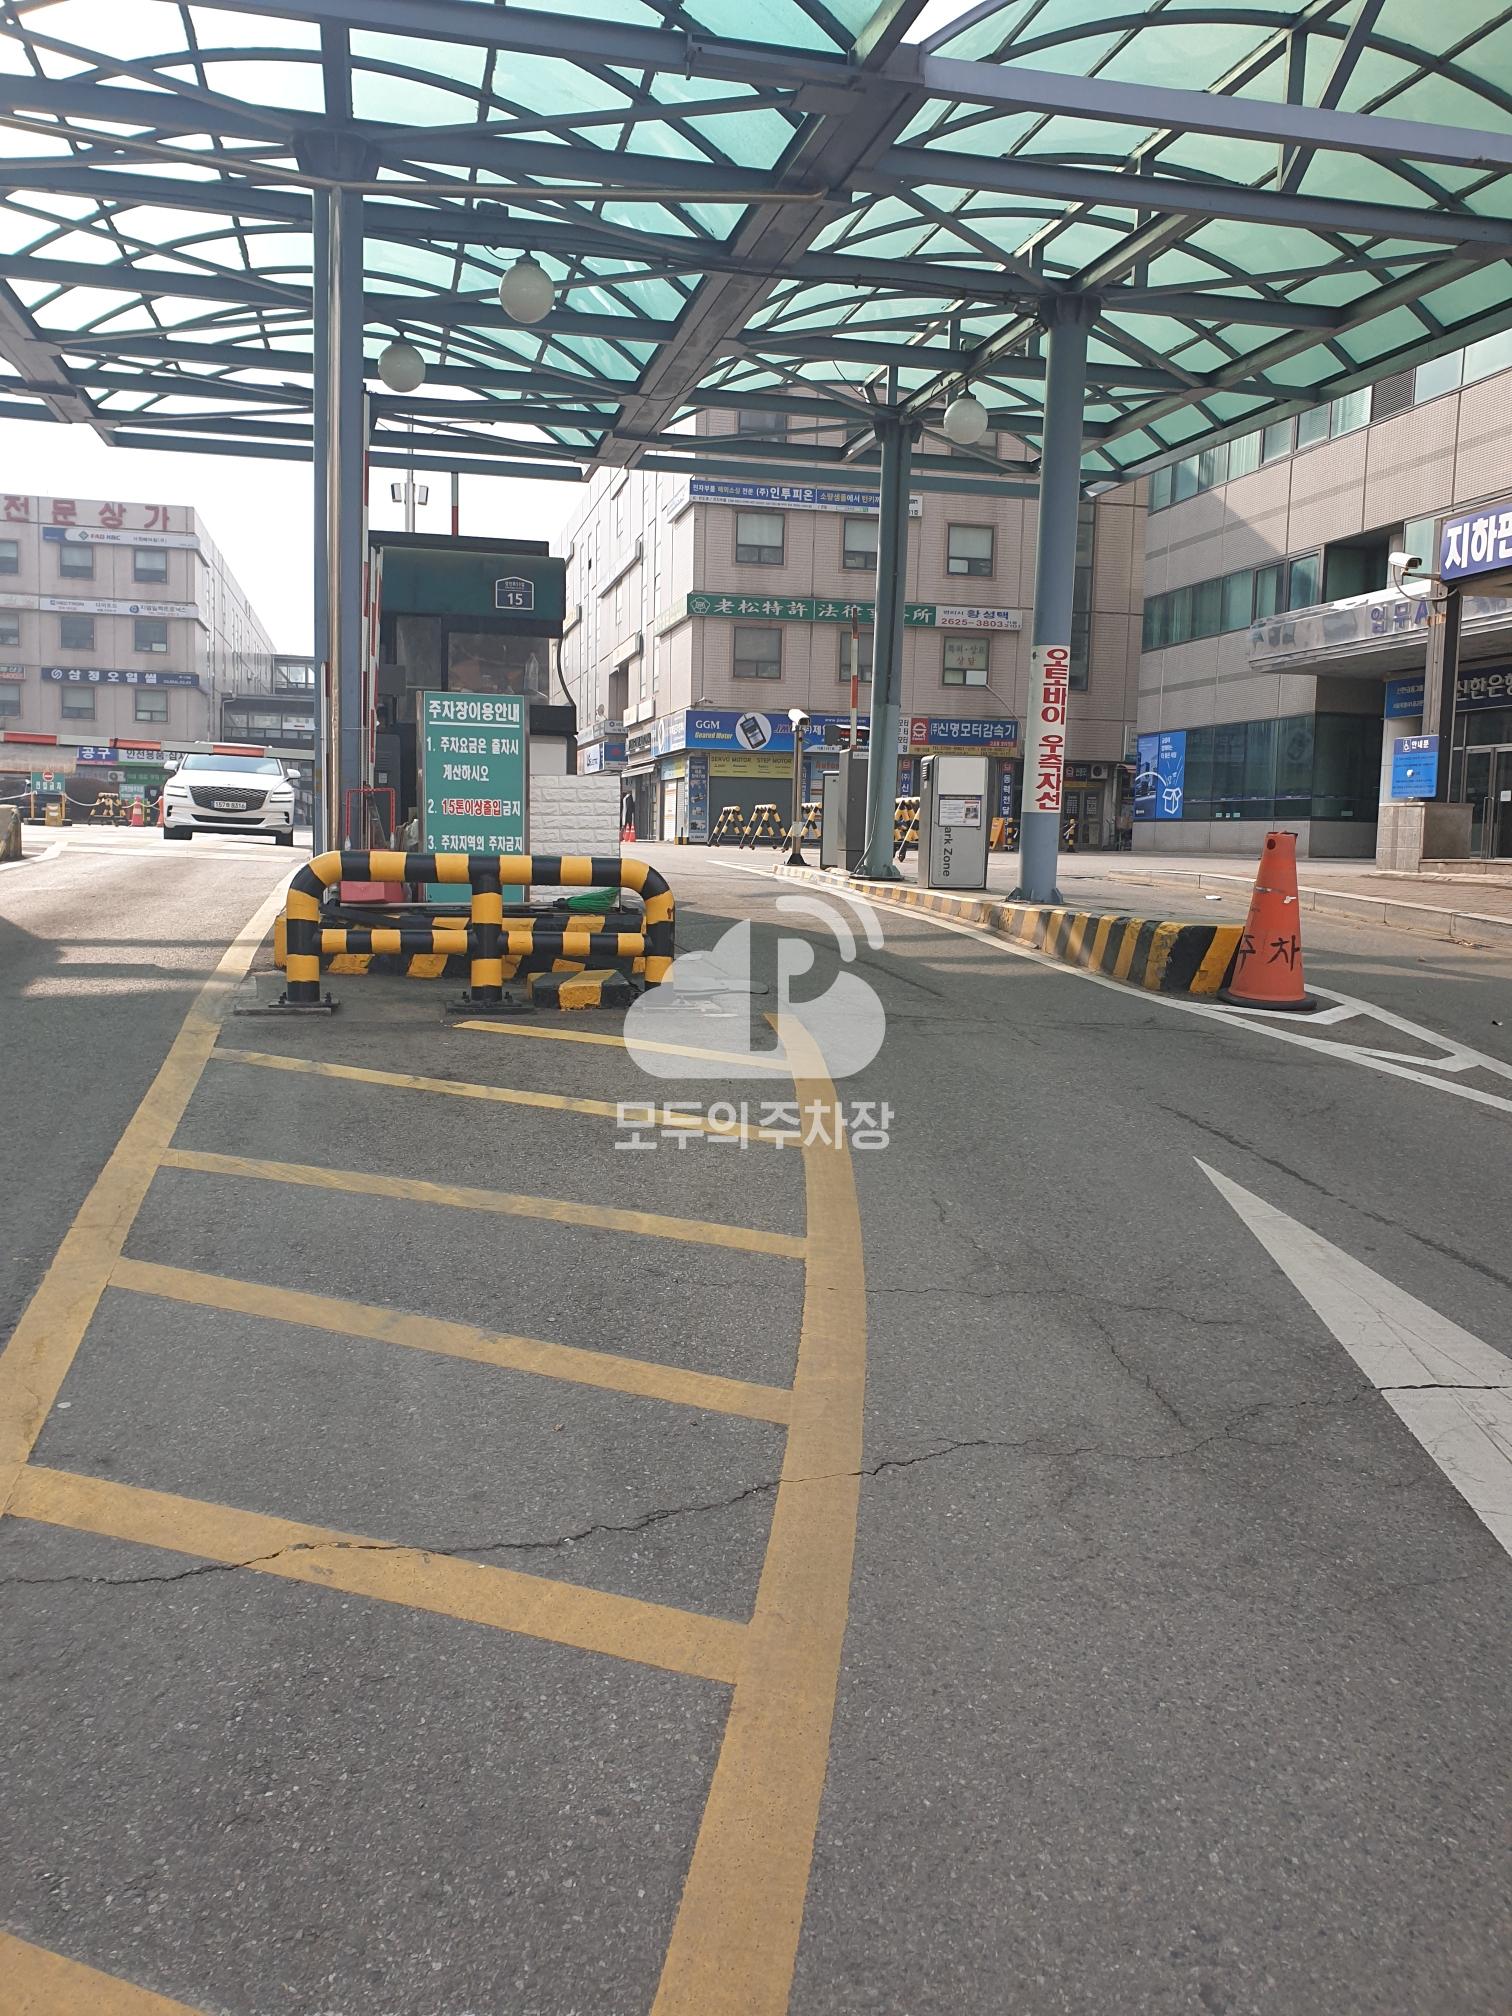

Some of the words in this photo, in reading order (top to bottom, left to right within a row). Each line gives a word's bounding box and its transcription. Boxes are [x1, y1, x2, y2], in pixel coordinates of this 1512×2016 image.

[507, 592, 523, 605] 15
[714, 598, 809, 618] 老松特許
[967, 609, 1009, 620] 황성택
[941, 617, 1003, 628] 2625-3803
[1040, 648, 1069, 725] 오토바이
[428, 700, 520, 722] 주차장이용안내
[695, 719, 720, 729] GGM
[440, 736, 487, 754] 주차요금은
[442, 764, 490, 782] 계산하시오
[441, 834, 485, 851] 주차지역외
[489, 835, 523, 852] 주차금지
[943, 825, 954, 845] ark
[942, 847, 953, 878] Zone
